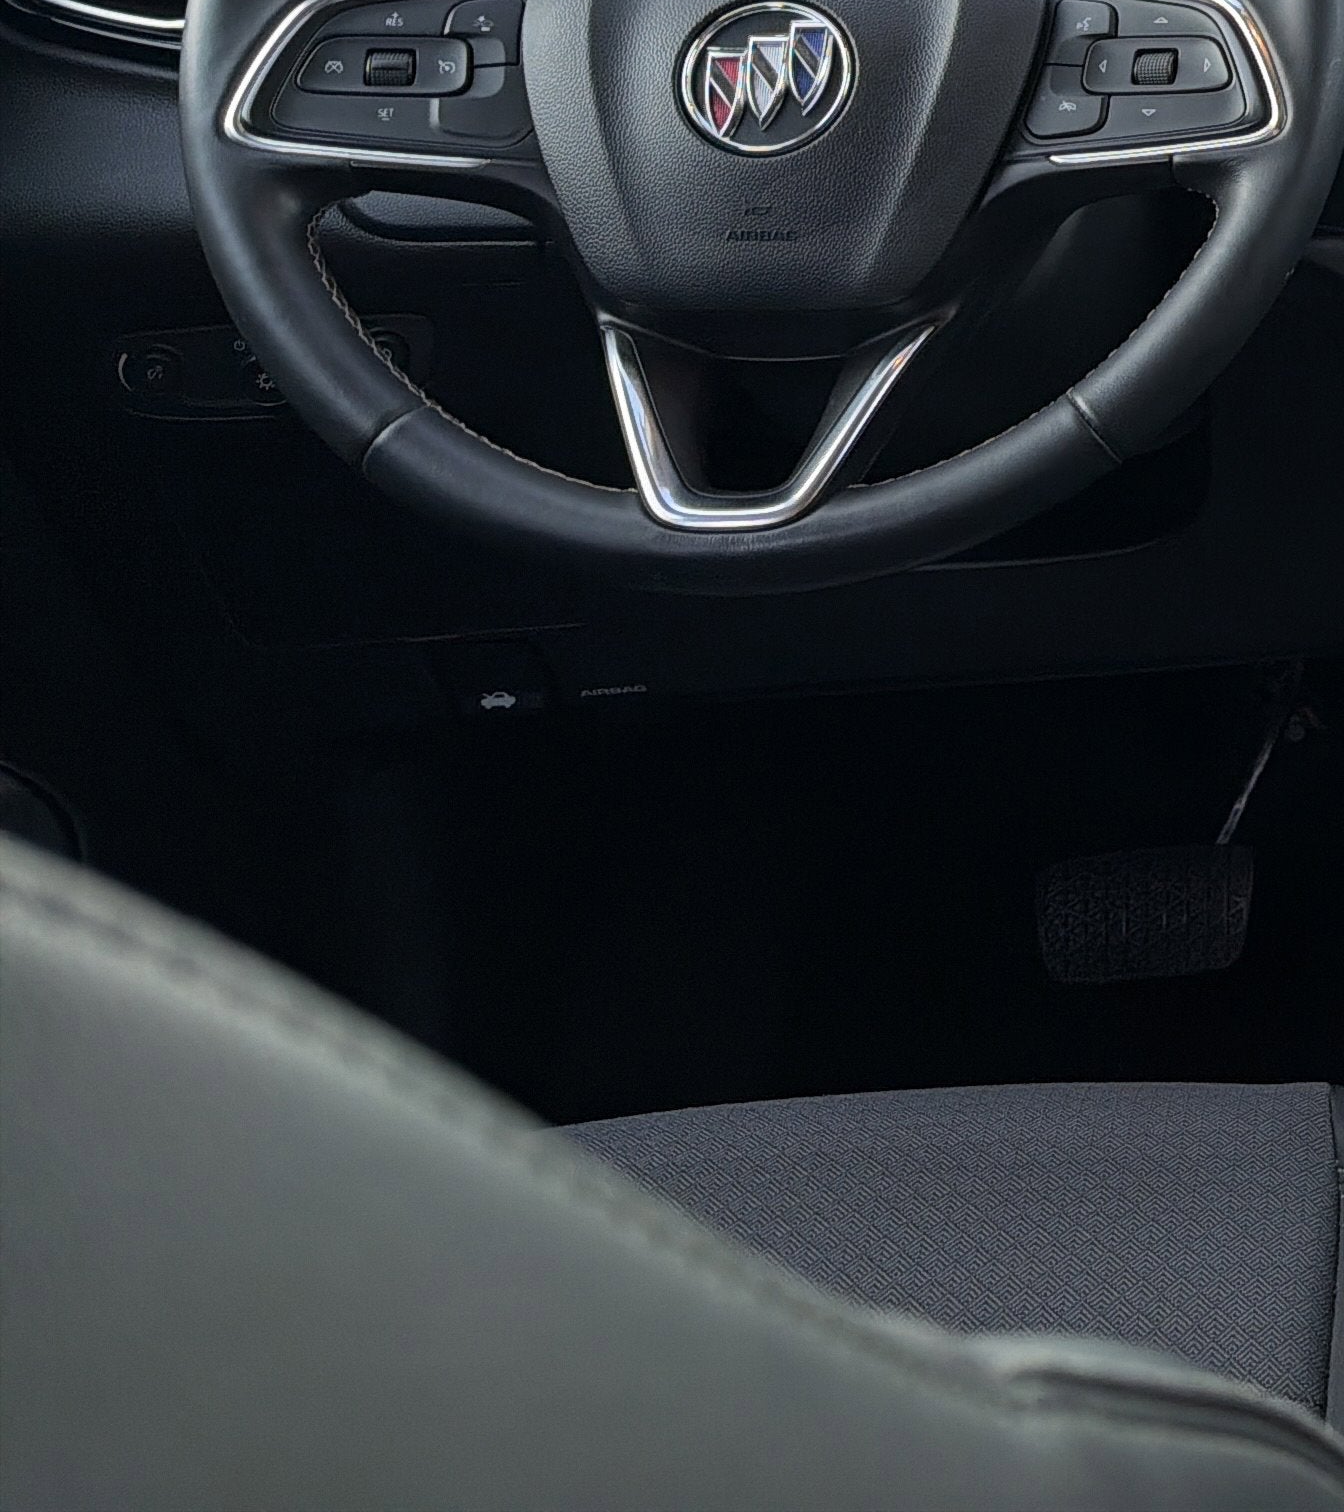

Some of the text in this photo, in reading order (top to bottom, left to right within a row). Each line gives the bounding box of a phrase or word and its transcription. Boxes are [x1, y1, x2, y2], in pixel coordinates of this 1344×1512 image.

[385, 16, 404, 27] RES
[377, 107, 394, 118] SET
[725, 230, 798, 242] AIRBAG
[580, 684, 648, 697] AIRBAG
